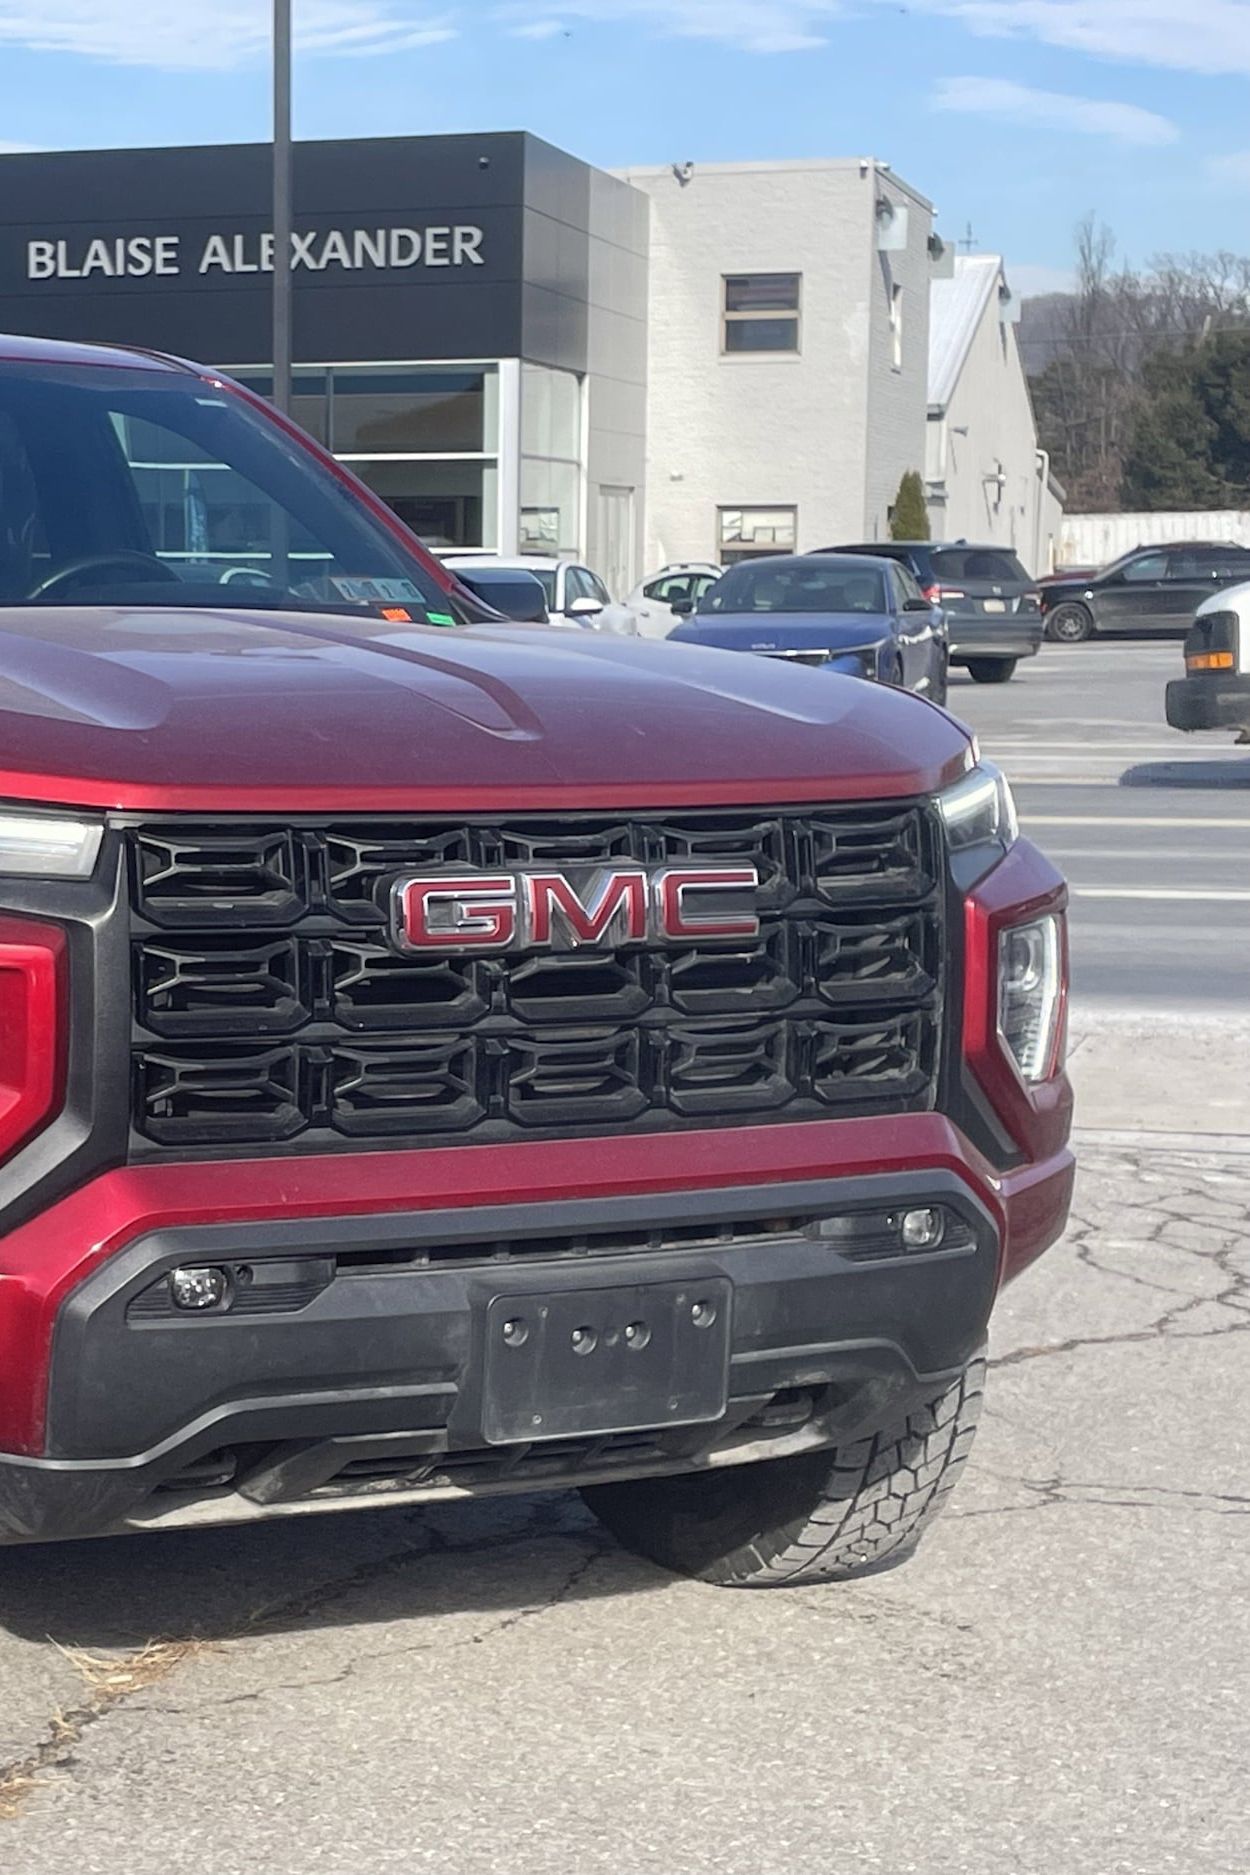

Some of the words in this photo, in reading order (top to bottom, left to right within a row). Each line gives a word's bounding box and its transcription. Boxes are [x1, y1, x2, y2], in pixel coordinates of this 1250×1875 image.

[27, 236, 180, 279] BLAISE
[198, 226, 485, 274] ALEXANDER
[392, 868, 760, 948] GMC
